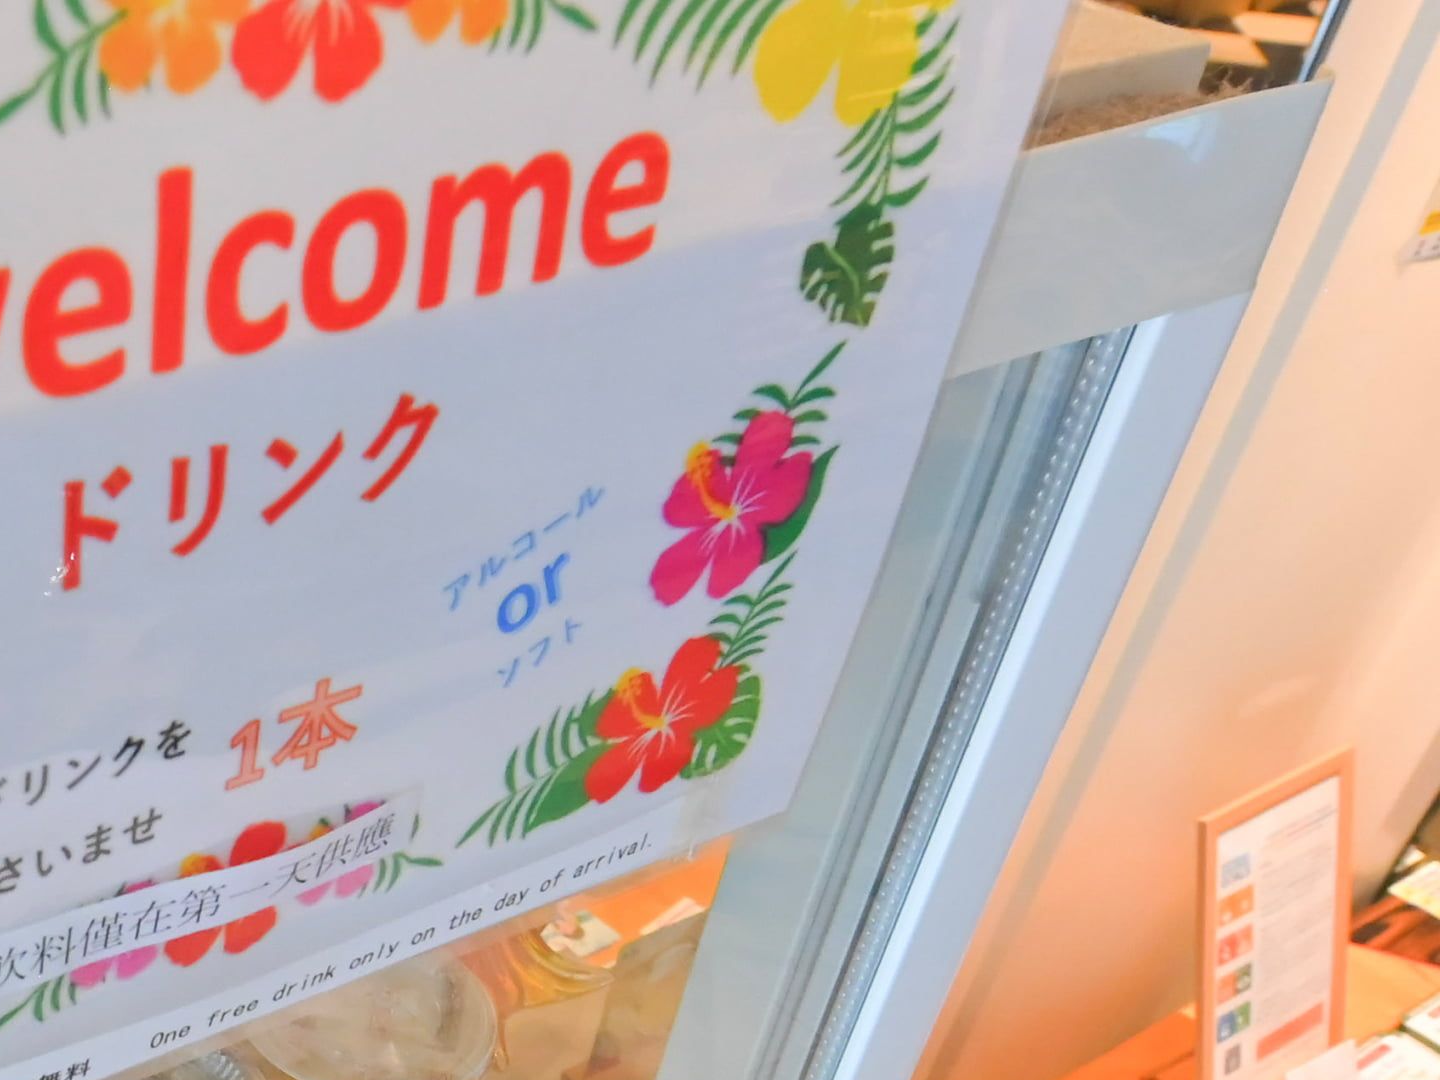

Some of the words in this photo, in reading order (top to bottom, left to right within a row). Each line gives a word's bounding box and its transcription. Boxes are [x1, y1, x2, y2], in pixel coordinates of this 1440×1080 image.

[63, 393, 440, 592] ドリンク
[442, 480, 605, 612] アルコール
[495, 551, 573, 635] or
[496, 615, 584, 688] ソフト
[224, 676, 363, 791] 1本
[149, 1022, 191, 1050] One
[206, 999, 258, 1029] free
[272, 965, 335, 1002] drink
[348, 936, 400, 971] only
[410, 925, 436, 946] on
[447, 903, 484, 930] the
[493, 884, 531, 920] day
[538, 868, 563, 893] of
[572, 832, 653, 880] arrival.
